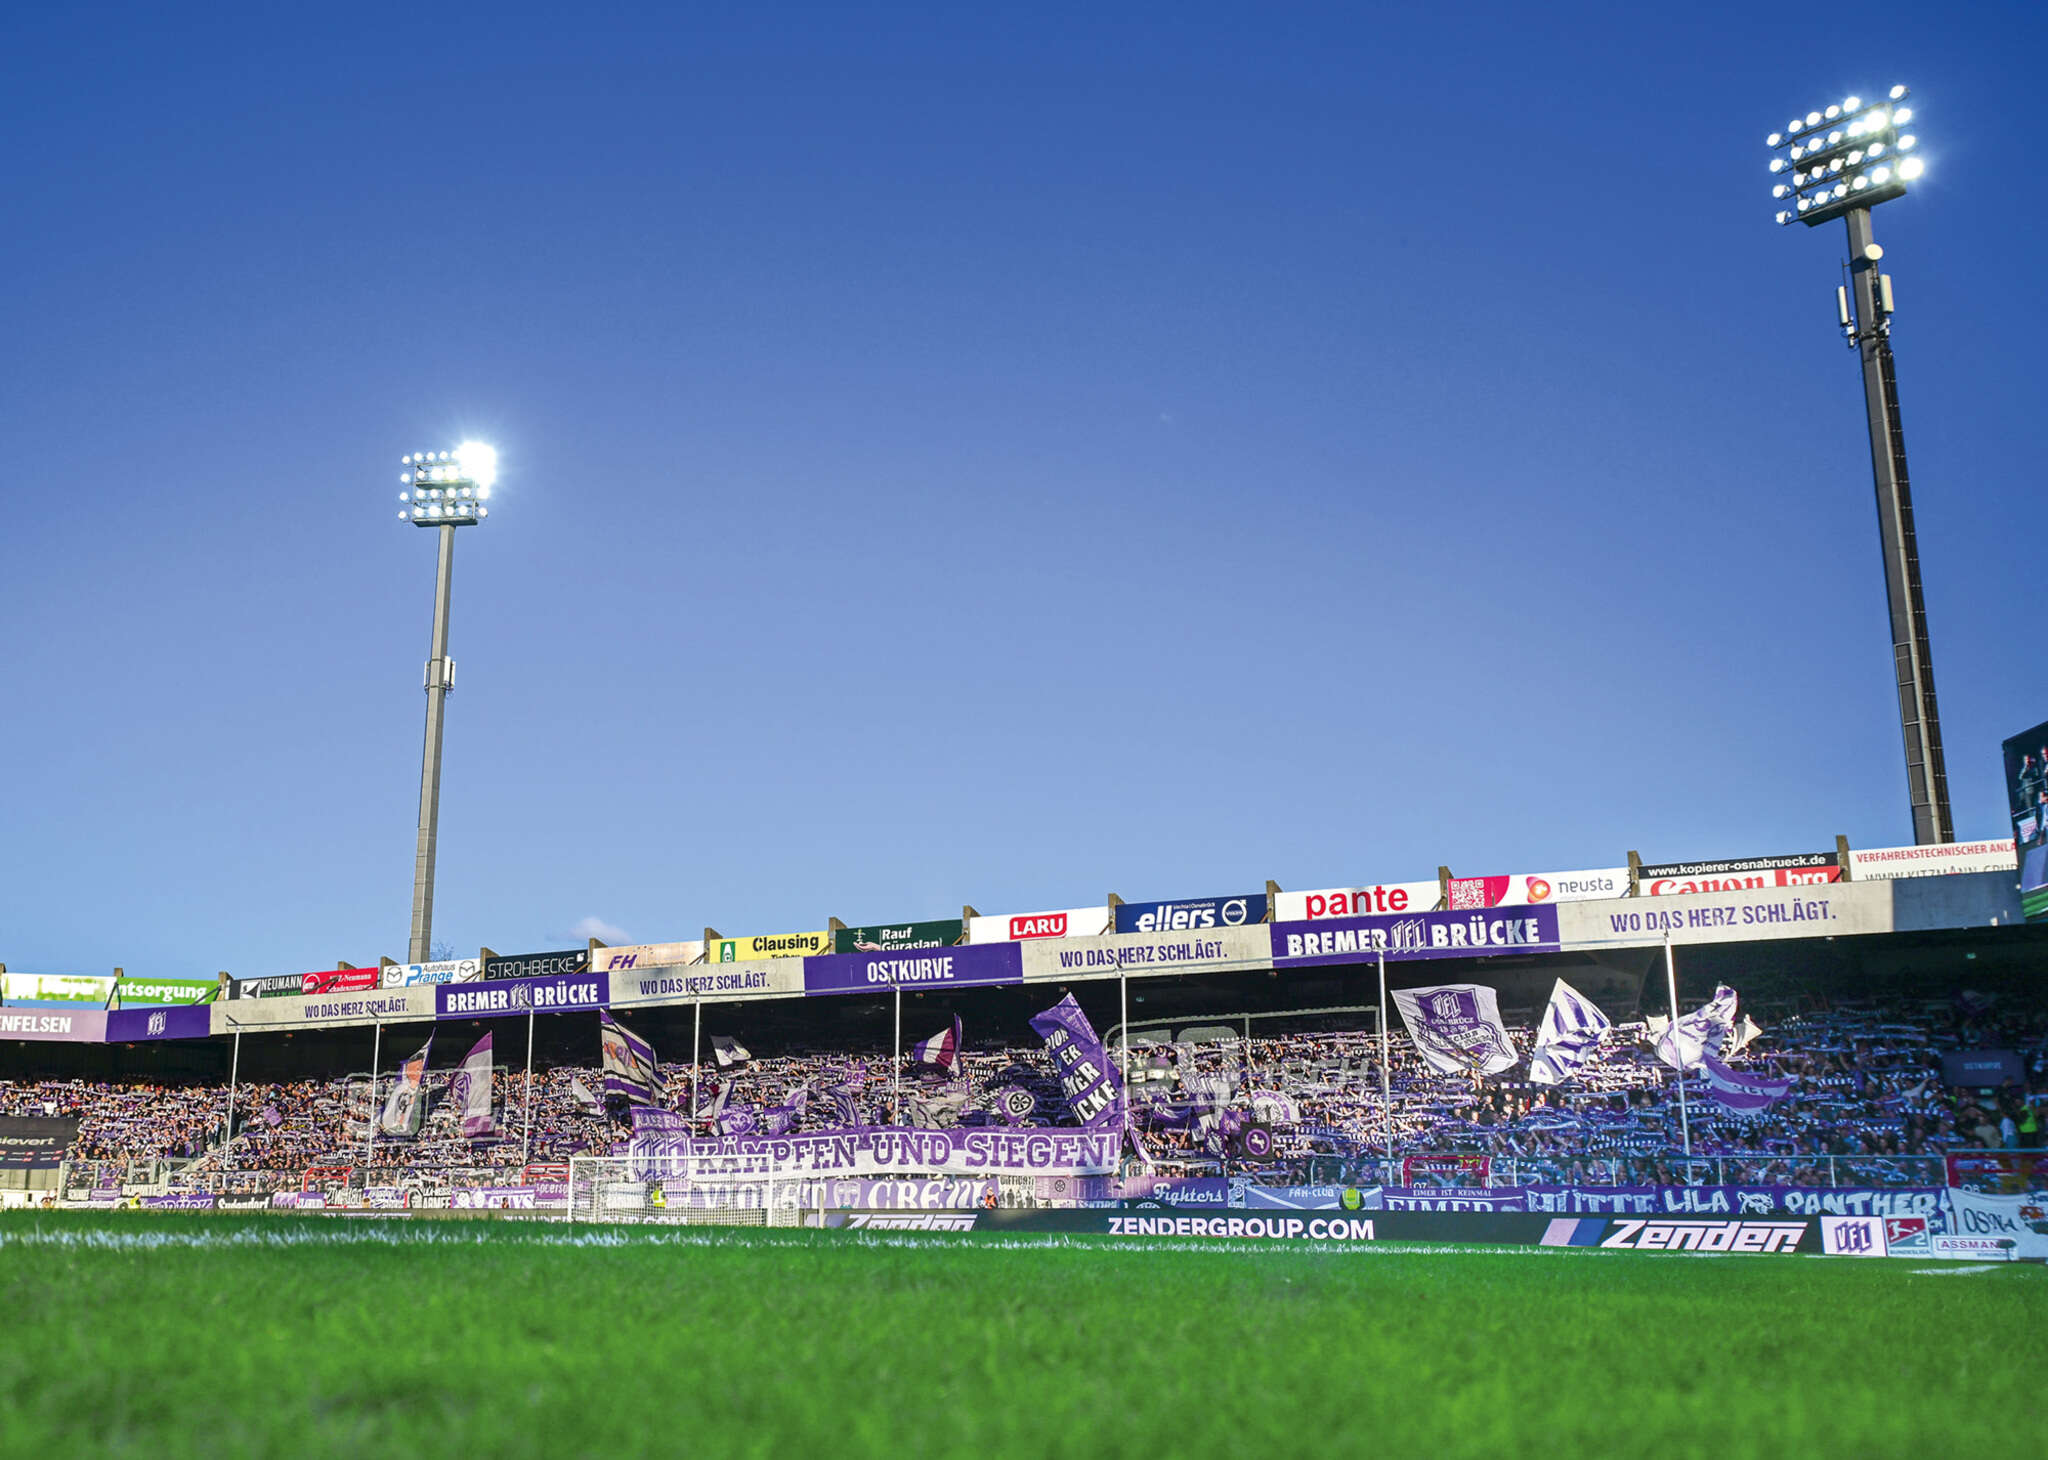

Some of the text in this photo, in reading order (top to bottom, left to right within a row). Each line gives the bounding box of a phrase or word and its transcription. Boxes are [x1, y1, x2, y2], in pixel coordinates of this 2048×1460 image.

[1648, 855, 1827, 878] www.kopierer-osnabrueck.de
[1559, 877, 1613, 893] neusta
[1305, 886, 1408, 921] pante
[1135, 905, 1216, 933] ellers
[1610, 898, 1837, 933] WO DAS HERZ SCHLÄGT.
[881, 927, 913, 940] Rauf
[1013, 918, 1064, 937] LARU
[1288, 928, 1388, 957] BREMER
[1431, 915, 1540, 948] BRÜCKE
[753, 936, 819, 952] Clausing
[1060, 940, 1227, 967] WO DAS HERZ SCHLÄGT.
[488, 956, 575, 978] STROHBECKE
[608, 954, 638, 969] FH
[867, 957, 954, 983] OSTKURVE
[260, 975, 303, 990] NEUMANN
[640, 971, 770, 995] WO DAS HERZ SCHLÄGT.
[305, 997, 409, 1018] WO DAS HERZ SCHLÄGT.
[447, 990, 508, 1012] BREMER
[534, 981, 598, 1006] BRÜCKE
[0, 1015, 72, 1034] NFELSEN
[872, 1133, 951, 1167] UND
[965, 1133, 1118, 1168] SIEGEN!
[1153, 1182, 1224, 1204] Fighters
[1108, 1217, 1374, 1240] ZENDERGROUP.COM
